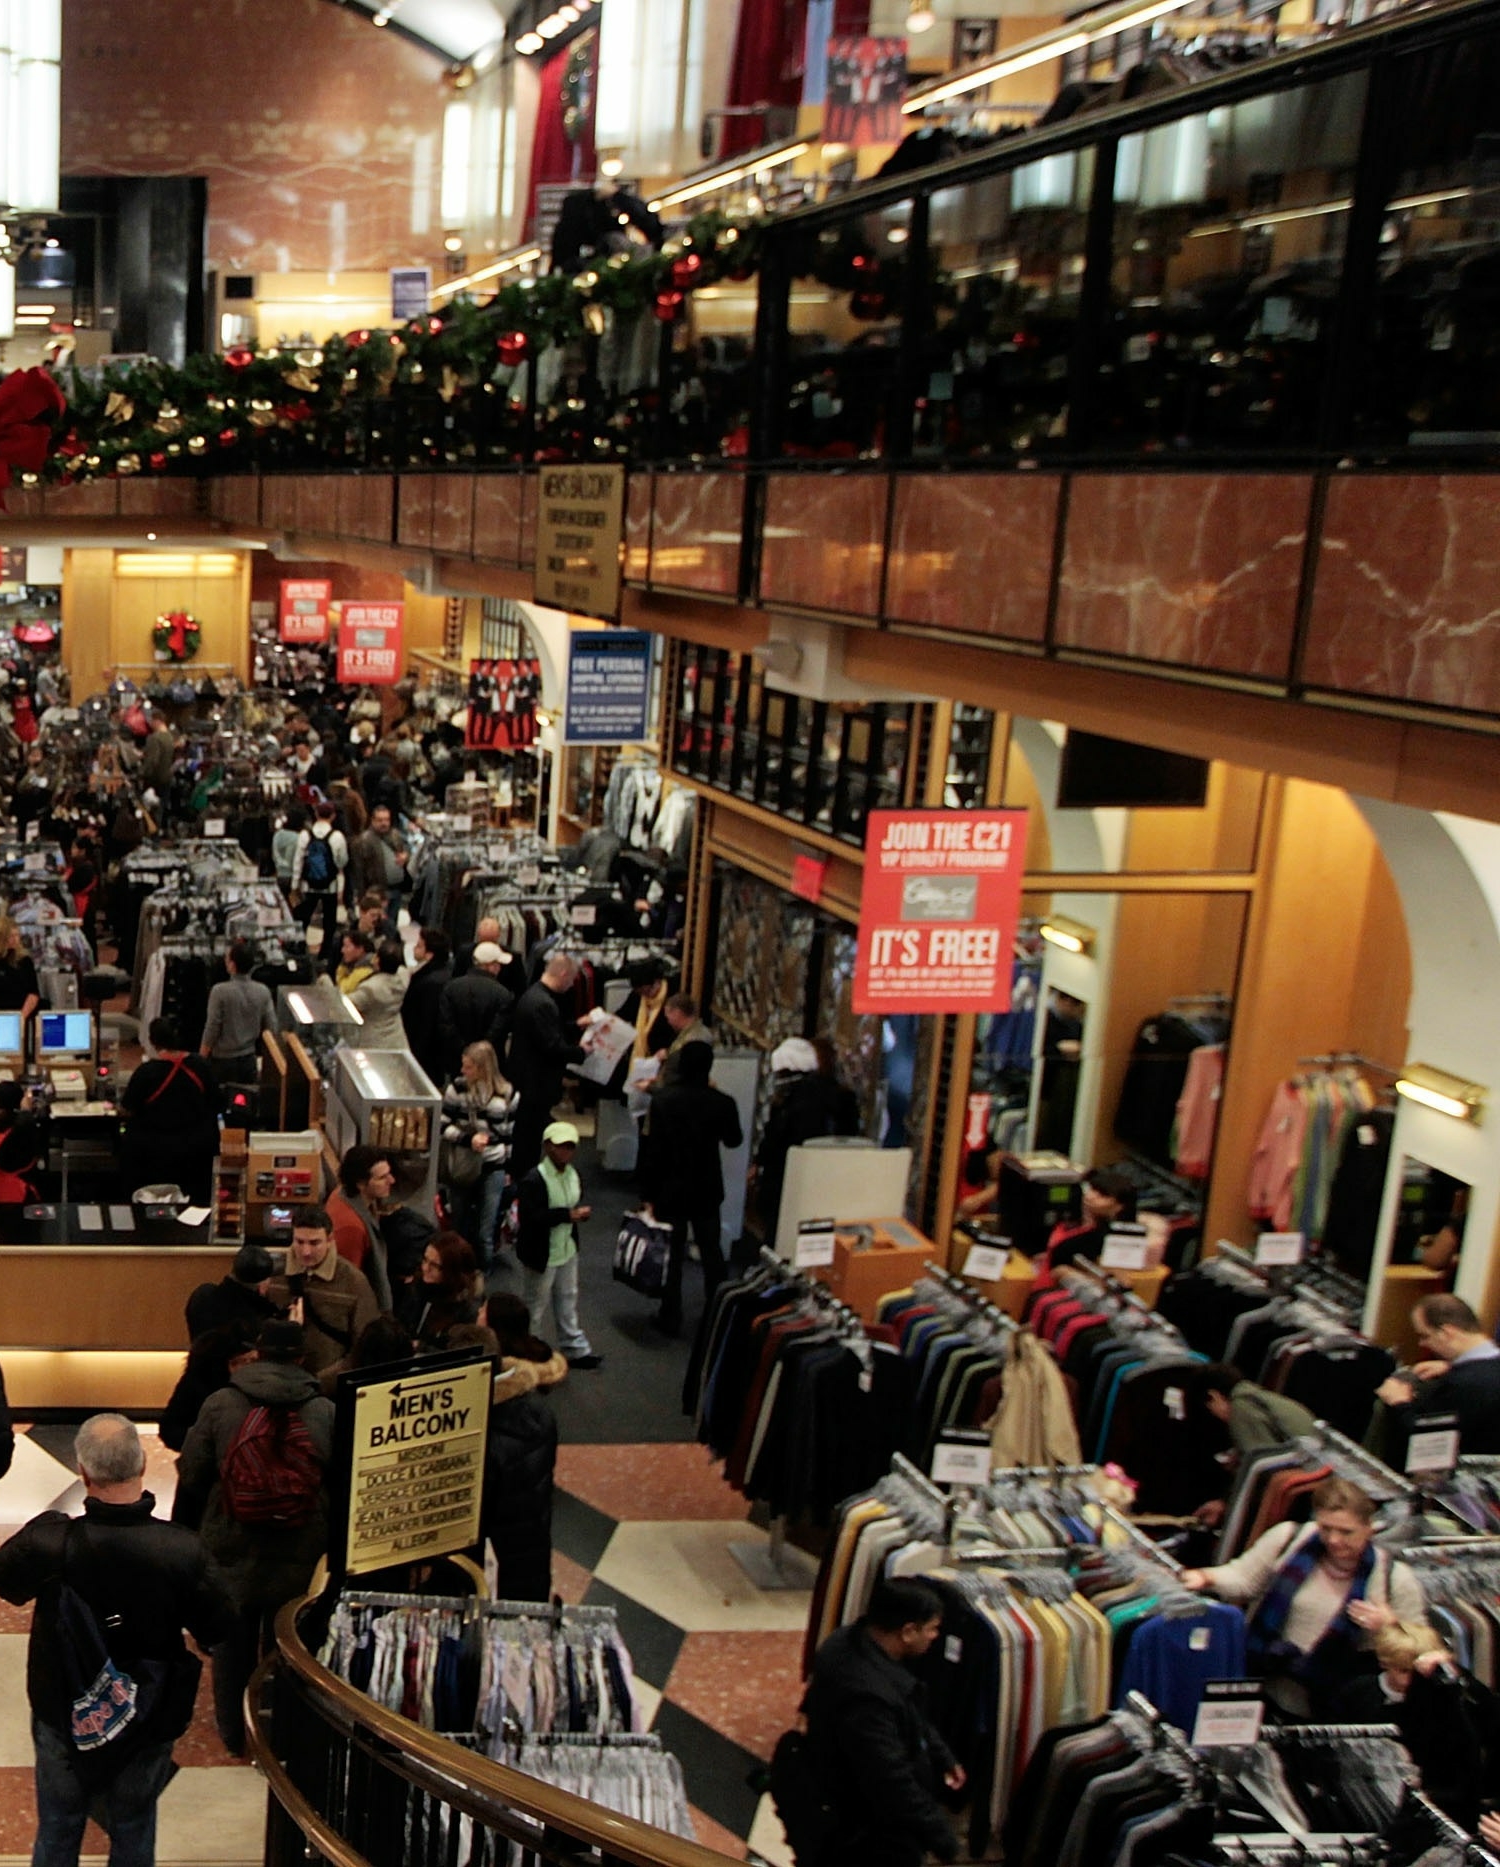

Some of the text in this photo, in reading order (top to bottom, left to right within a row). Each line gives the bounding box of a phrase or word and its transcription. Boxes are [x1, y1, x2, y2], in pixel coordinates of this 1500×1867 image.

[881, 822, 1012, 850] JOIN THE C21
[869, 929, 999, 966] IT'S FREE!
[390, 1388, 453, 1420] MEN'S
[370, 1407, 470, 1447] BALCONY
[366, 1469, 407, 1488] DOLCE
[418, 1452, 472, 1477] GABBANA
[412, 1471, 475, 1495] COLLECTION
[358, 1508, 385, 1525] JEAN
[388, 1502, 415, 1519] PAUL
